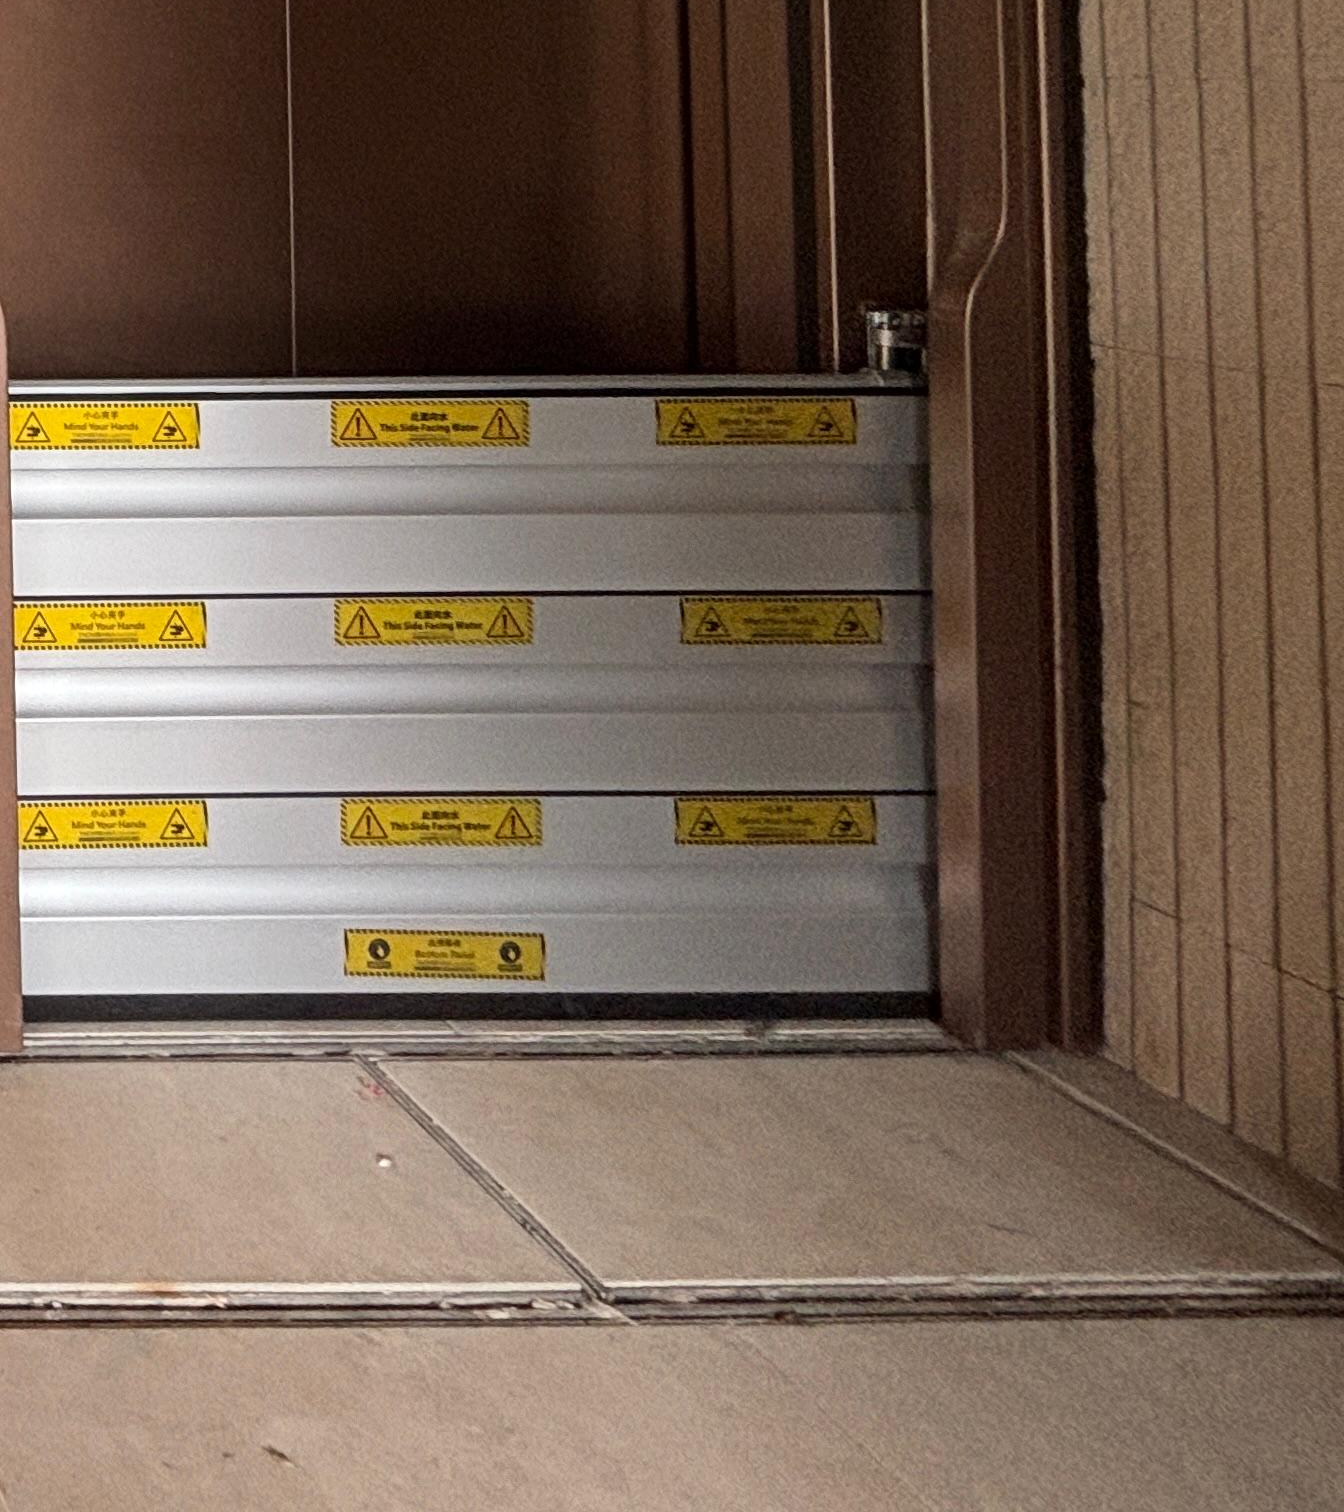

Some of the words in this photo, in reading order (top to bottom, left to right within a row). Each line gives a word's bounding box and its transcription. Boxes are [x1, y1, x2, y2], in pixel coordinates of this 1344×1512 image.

[381, 424, 398, 432] This
[401, 424, 420, 432] Side
[421, 424, 449, 433] Facing
[452, 424, 479, 432] Water
[71, 622, 93, 630] Mind
[96, 622, 115, 630] Your
[118, 622, 145, 630] Hands
[384, 622, 401, 630] This
[404, 622, 423, 630] Side
[425, 622, 453, 631] Facing
[456, 622, 483, 630] Water
[72, 821, 94, 829] Mind
[97, 821, 116, 829] Your
[119, 821, 146, 829] Hands
[391, 822, 409, 830] This
[411, 822, 430, 830] Side
[432, 822, 461, 832] Facing
[464, 822, 491, 830] Water
